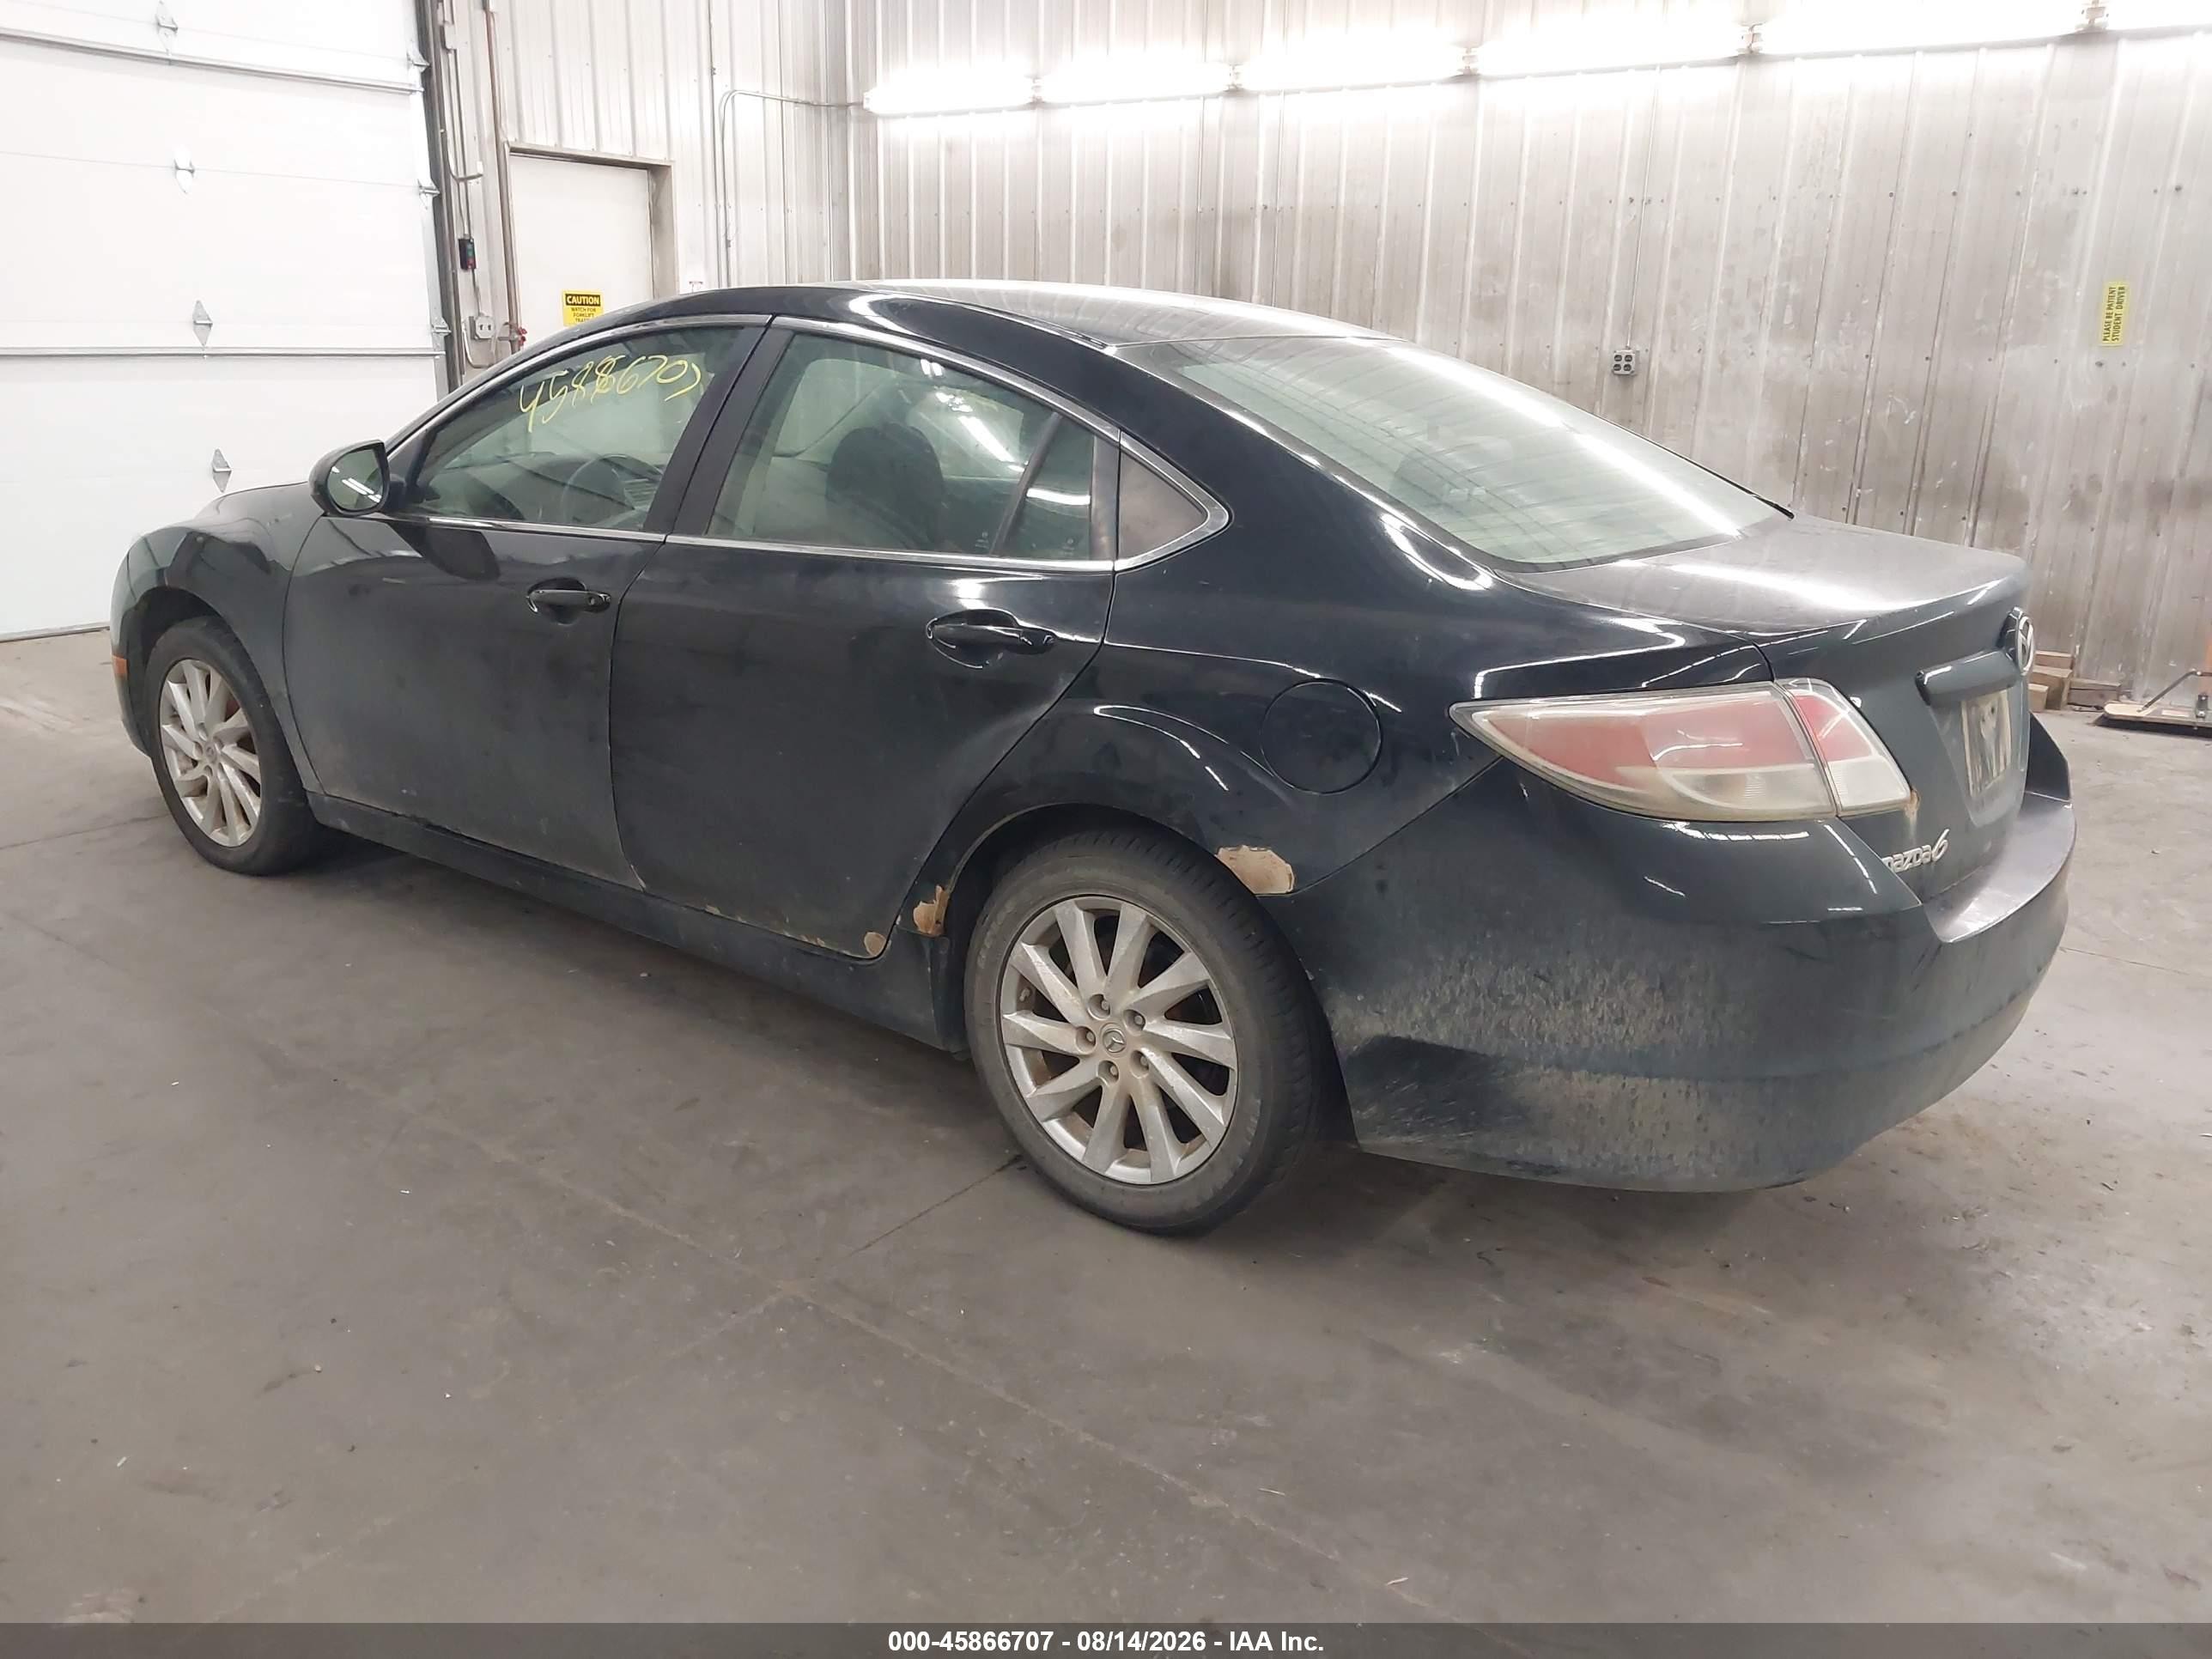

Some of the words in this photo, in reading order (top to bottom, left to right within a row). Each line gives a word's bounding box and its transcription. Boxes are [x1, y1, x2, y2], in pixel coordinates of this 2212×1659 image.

[567, 295, 600, 305] CAUTION
[2106, 287, 2117, 310] PATIENT
[2115, 286, 2125, 310] DRIVER
[2102, 320, 2112, 342] PLEASE
[2112, 313, 2123, 342] STUDENT
